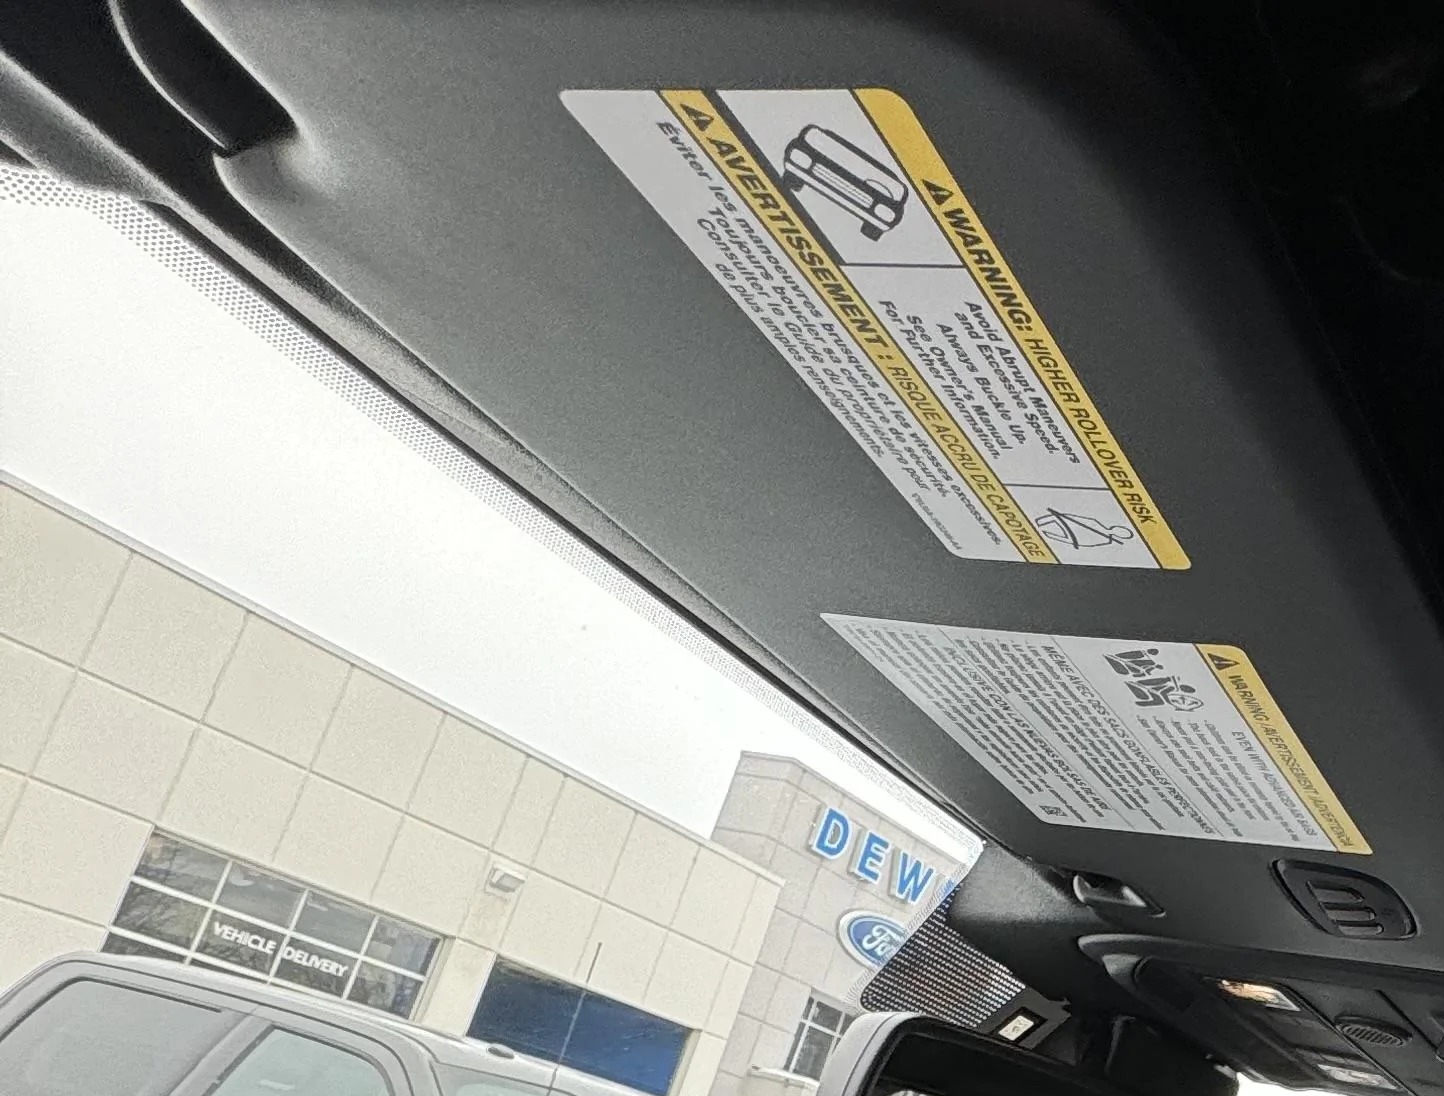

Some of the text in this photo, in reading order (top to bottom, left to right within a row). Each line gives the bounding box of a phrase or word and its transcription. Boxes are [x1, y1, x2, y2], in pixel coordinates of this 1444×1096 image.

[654, 121, 721, 180] Éviter
[706, 185, 742, 211] les
[732, 217, 824, 317] manoeuvres
[814, 322, 883, 388] brusques
[874, 392, 897, 405] et
[888, 410, 915, 428] les
[905, 431, 958, 481] vitesses
[693, 218, 774, 298] Consulter
[764, 302, 789, 316] le
[780, 321, 829, 363] Guide
[819, 367, 847, 385] du
[900, 467, 931, 490] pour
[700, 206, 778, 280] Toujours
[768, 285, 829, 343] boucler
[819, 346, 843, 363] sa
[836, 367, 895, 424] ceinture
[885, 427, 911, 443] de
[705, 137, 889, 347] AVERTISSEMENT
[884, 366, 944, 421] RISQUE
[929, 423, 982, 470] ACCRU
[968, 474, 996, 490] DE
[982, 493, 1047, 557] CAPOTAGE
[711, 262, 741, 280] de
[728, 284, 767, 312] plus
[755, 316, 809, 361] amples
[939, 207, 1157, 524] WARNING: HIGHER ROLLOVER RISK
[876, 299, 1007, 459] For Further Information.
[903, 314, 1014, 449] See Owner's Manual
[931, 323, 1032, 445] Always Buckle Up.
[952, 312, 1063, 455] and Excessive Speed.
[963, 301, 1084, 463] Avoid Abrupt Maneuvers
[985, 692, 1014, 711] CON
[1004, 712, 1032, 729] LAS
[1064, 673, 1097, 698] AVEC
[1085, 698, 1112, 716] DES
[1100, 716, 1131, 739] SACS
[1223, 673, 1271, 721] WARNING
[1259, 726, 1320, 795] AVERTISSEMENT
[1229, 730, 1257, 752] EVEN
[1245, 752, 1271, 771] WITH
[812, 806, 956, 905] DEW
[213, 921, 349, 977] VEHICLE DELIVERY
